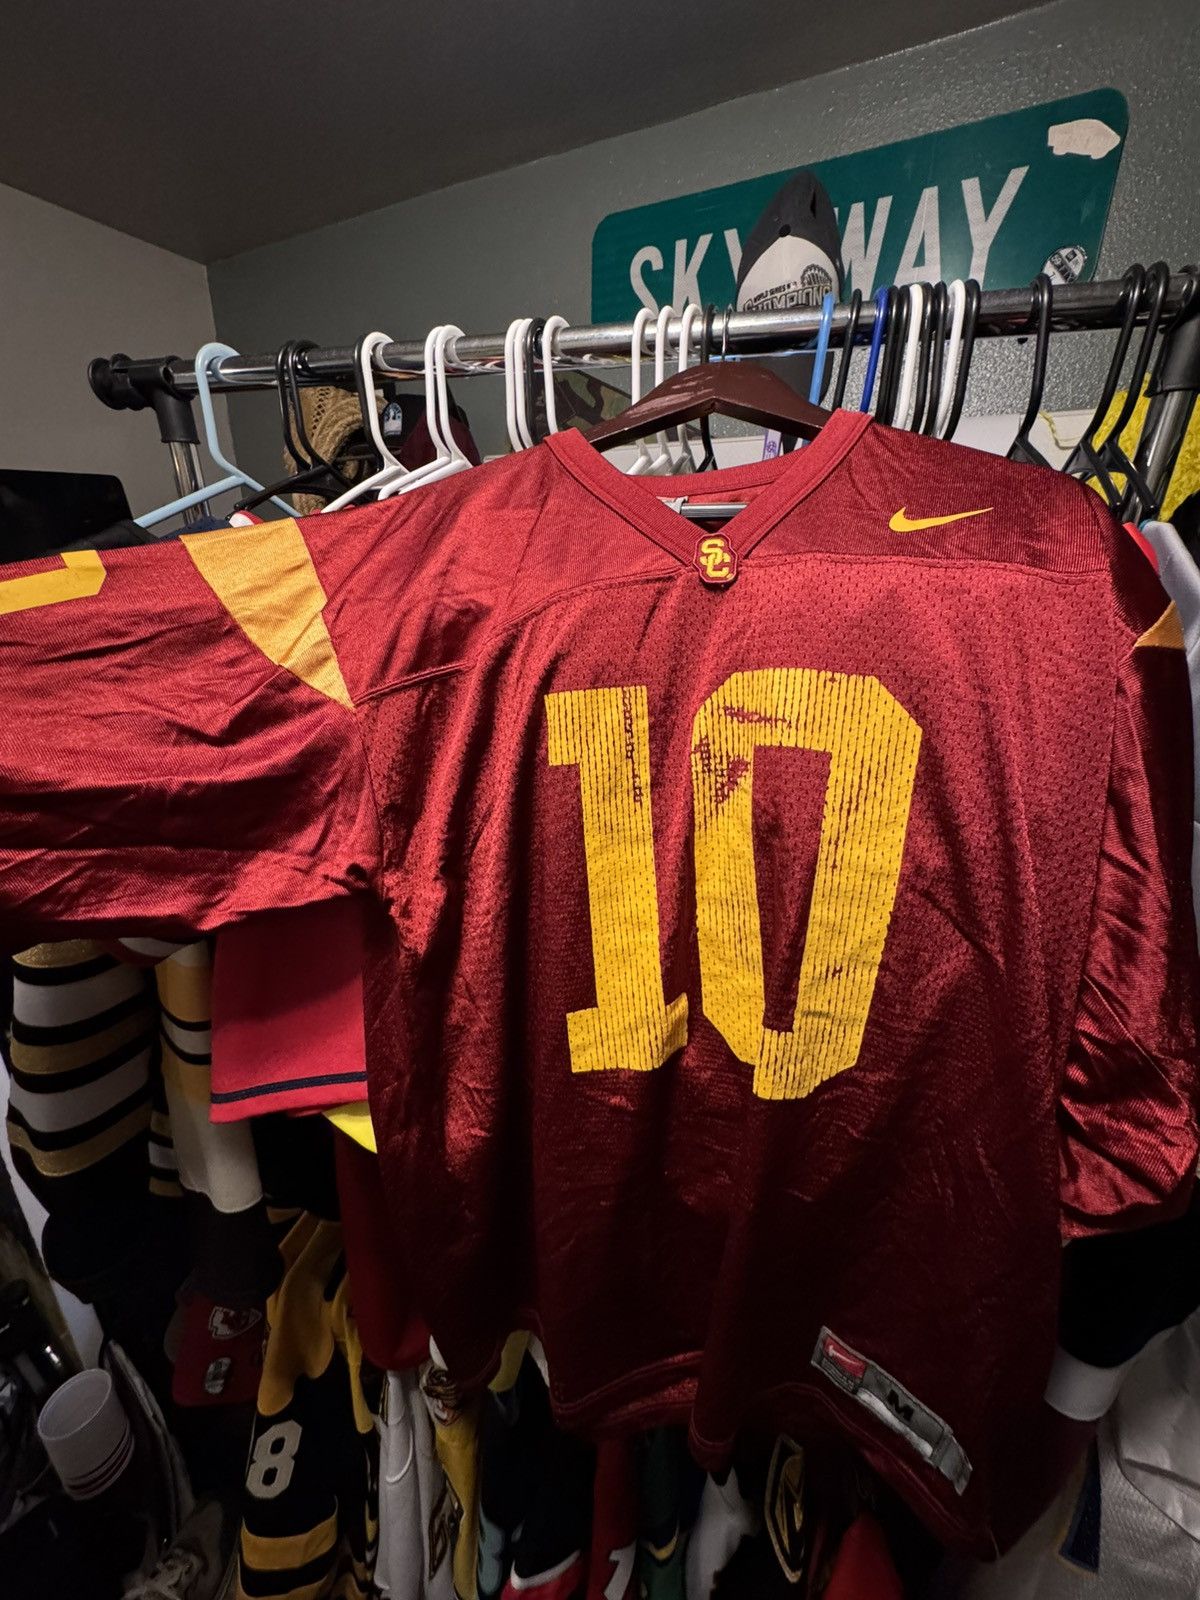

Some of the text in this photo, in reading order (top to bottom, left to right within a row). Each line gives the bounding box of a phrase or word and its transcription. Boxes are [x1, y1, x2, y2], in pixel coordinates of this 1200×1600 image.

[700, 538, 731, 577] SC
[544, 667, 923, 1100] 10
[887, 1390, 914, 1421] M
[245, 1420, 302, 1499] 8
